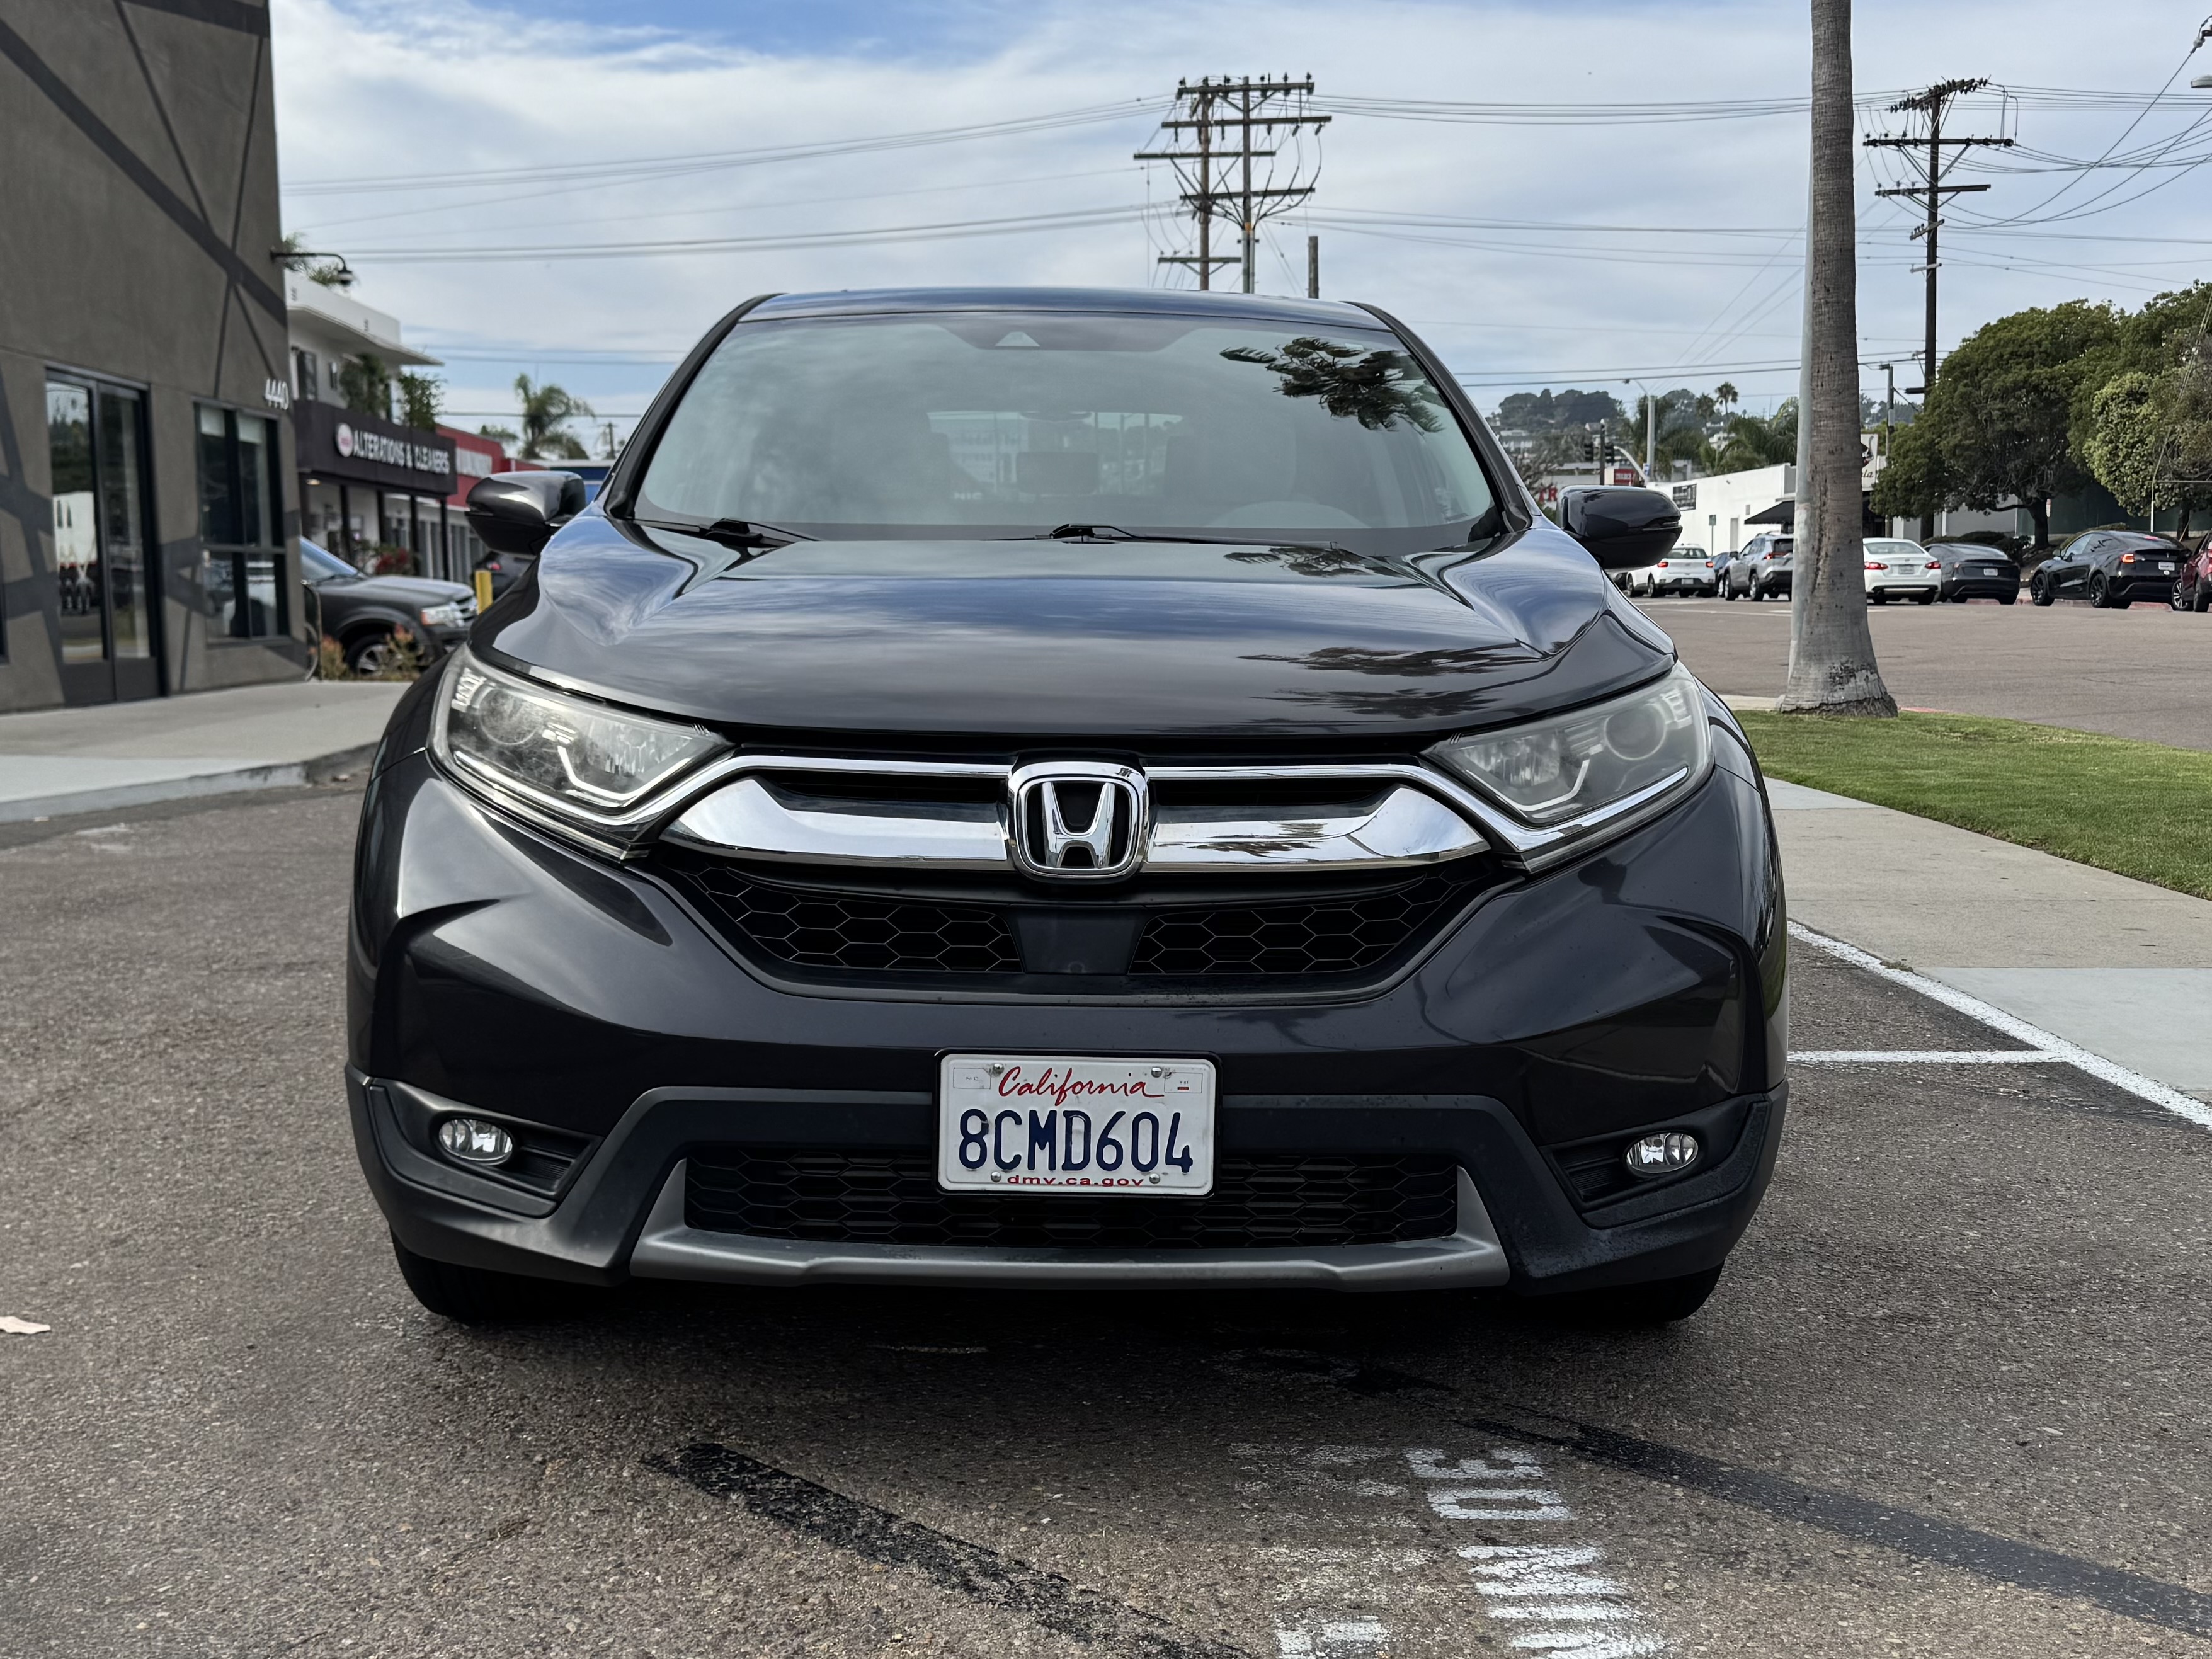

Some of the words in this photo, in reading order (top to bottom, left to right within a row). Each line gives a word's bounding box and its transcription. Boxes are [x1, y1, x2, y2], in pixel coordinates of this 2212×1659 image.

[354, 429, 404, 467] ALTERATIONS
[406, 443, 413, 469] &
[414, 445, 450, 474] CLEANERS
[999, 1066, 1164, 1106] California
[959, 1109, 1194, 1173] 8CMD604
[1008, 1175, 1144, 1187] dmv.ca.gov
